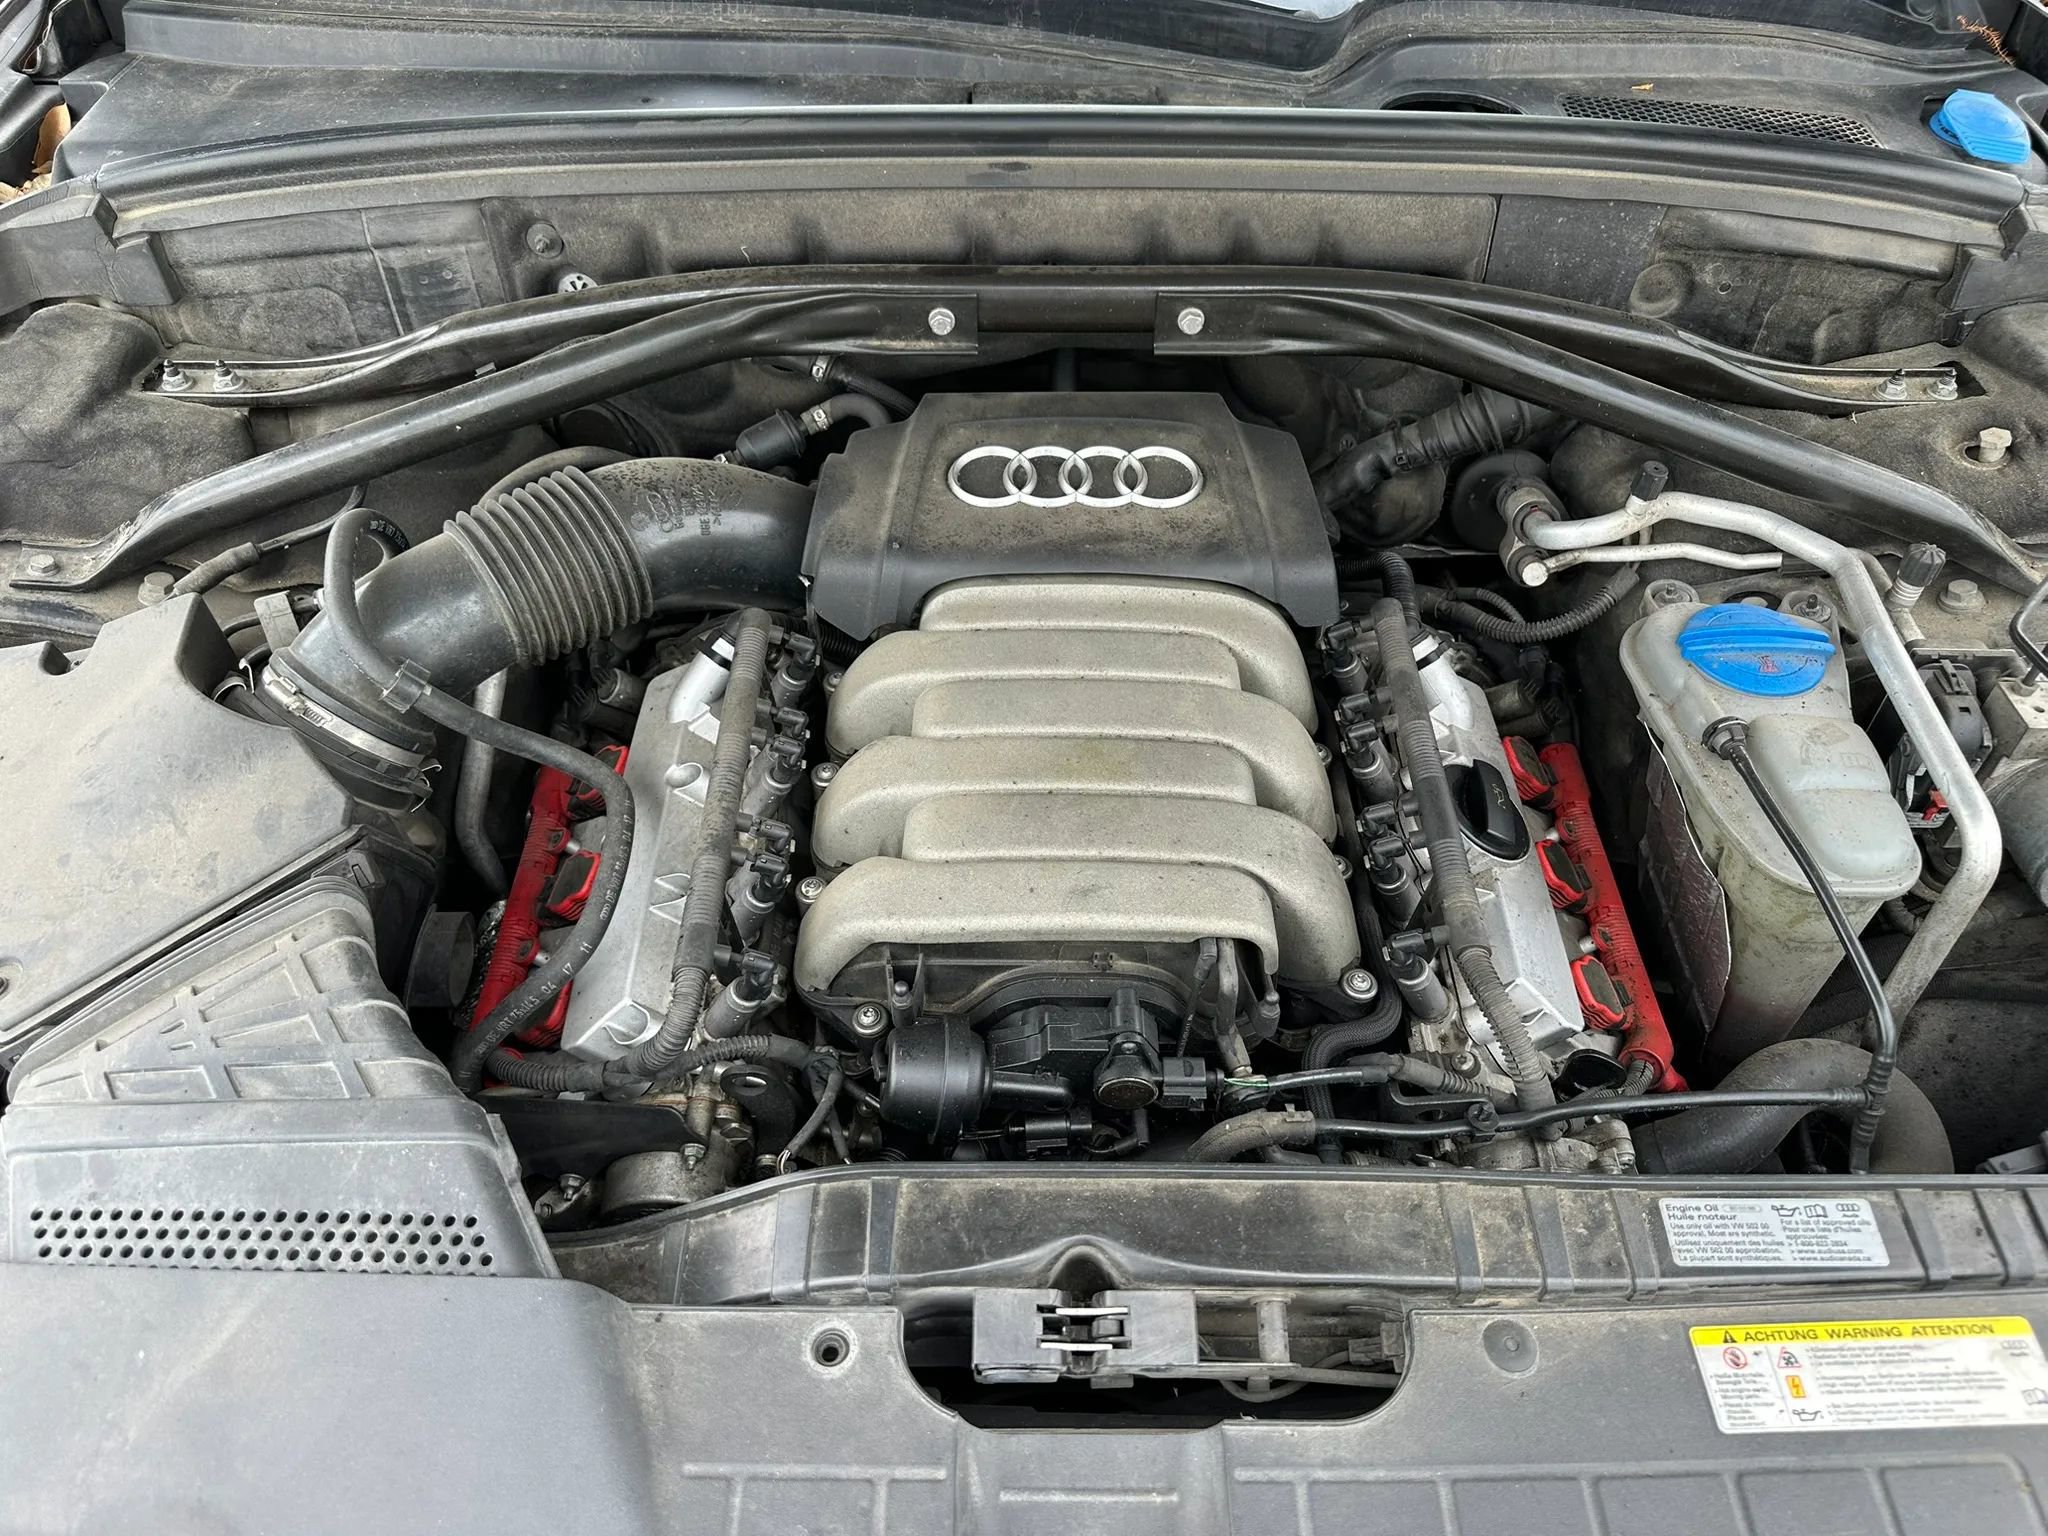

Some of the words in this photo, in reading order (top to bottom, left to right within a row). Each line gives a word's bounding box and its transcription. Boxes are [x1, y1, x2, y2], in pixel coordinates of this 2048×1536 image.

[496, 1016, 514, 1033] VRT
[541, 981, 557, 995] 04
[562, 962, 574, 976] 17
[579, 941, 593, 954] 11
[1665, 1203, 1701, 1214] Engine
[1704, 1203, 1719, 1212] Oil
[1668, 1212, 1694, 1220] Huile
[1686, 1222, 1701, 1231] only
[1744, 1328, 1818, 1342] ACHTUNG
[1824, 1325, 1903, 1340] WARNING
[1911, 1323, 1995, 1337] ATTENTION
